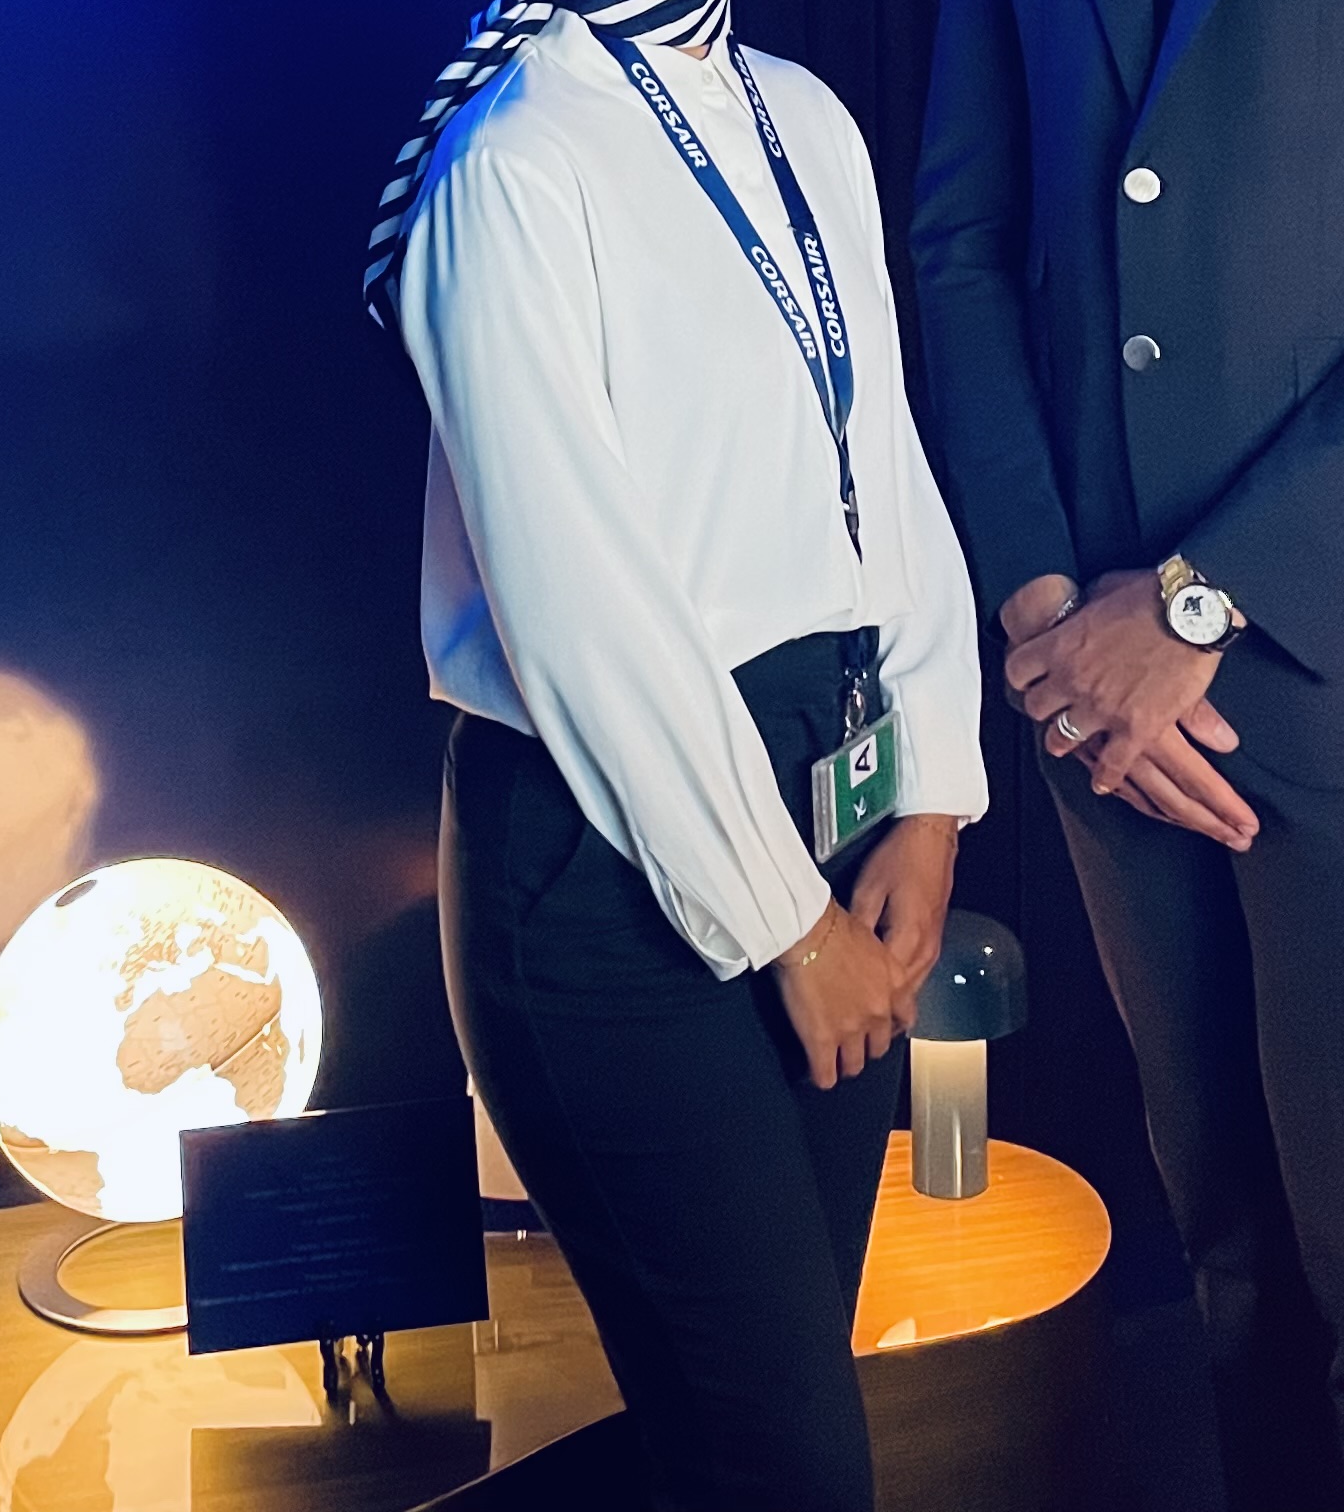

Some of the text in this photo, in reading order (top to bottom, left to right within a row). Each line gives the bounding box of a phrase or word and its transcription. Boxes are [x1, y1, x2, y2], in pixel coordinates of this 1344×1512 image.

[630, 61, 708, 169] CORSAIR
[750, 245, 817, 360] CORSAIR
[804, 236, 845, 358] CORSAIR
[855, 742, 871, 771] A
